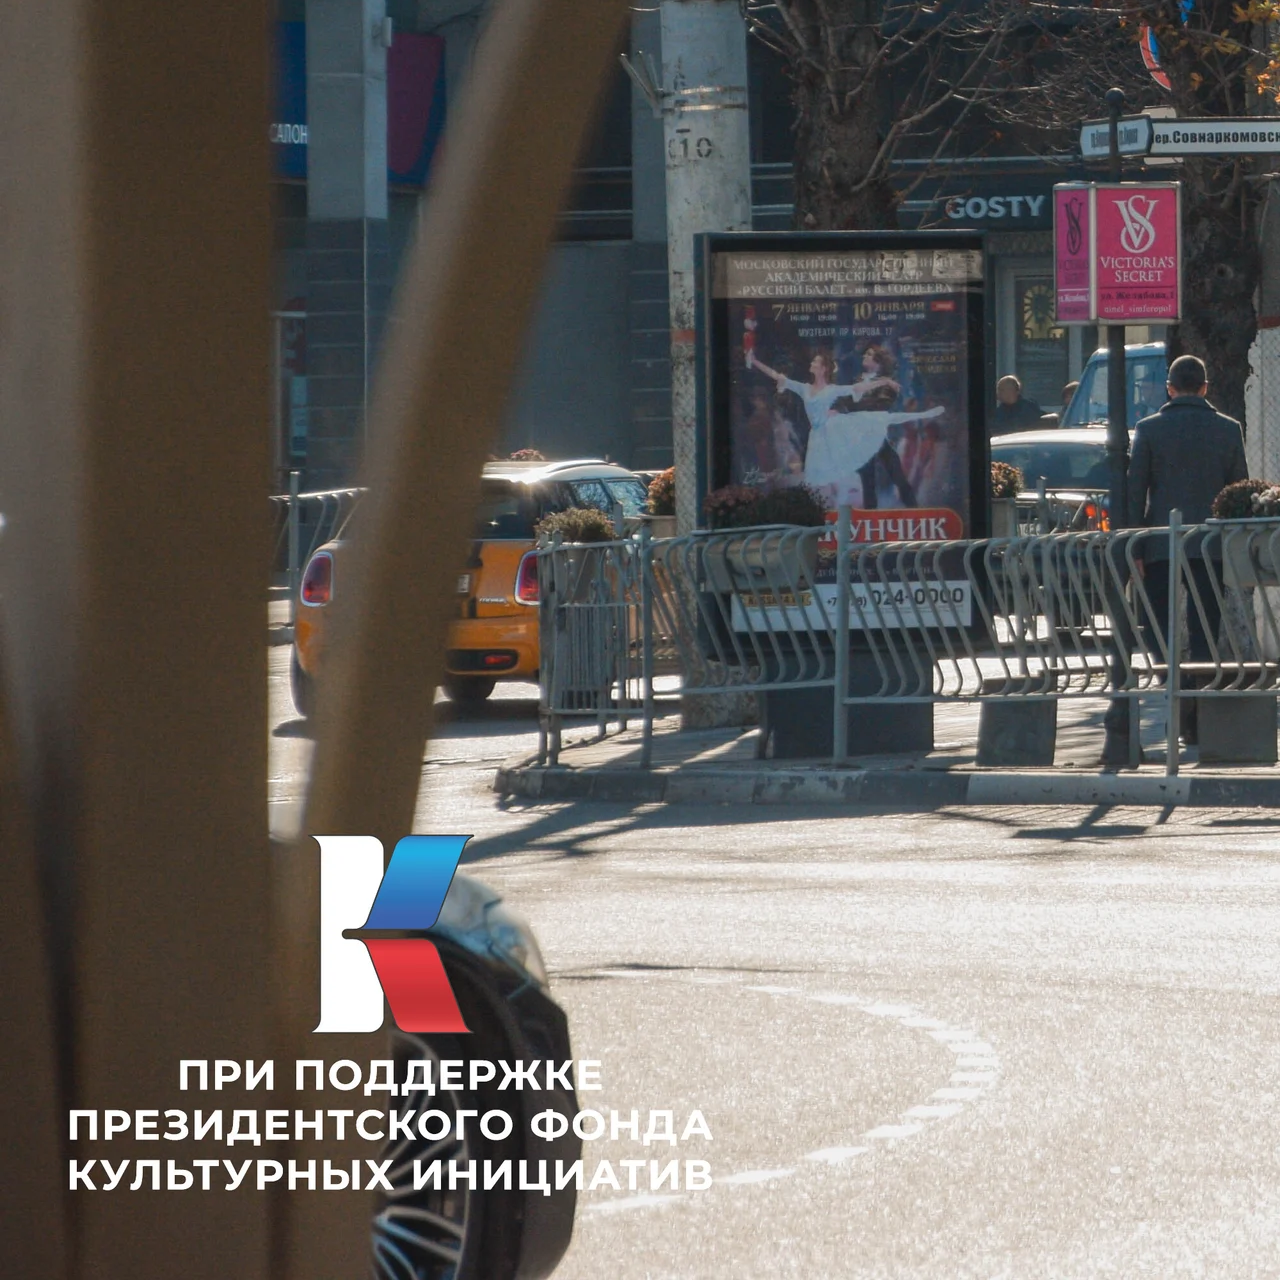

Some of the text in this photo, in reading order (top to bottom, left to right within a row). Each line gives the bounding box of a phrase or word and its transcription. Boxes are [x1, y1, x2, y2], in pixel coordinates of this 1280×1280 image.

[946, 195, 1045, 218] GOSTY
[1100, 256, 1174, 269] VICTORIA'S
[1115, 270, 1163, 282] SECRET
[771, 303, 785, 321] 7
[852, 302, 872, 320] 10
